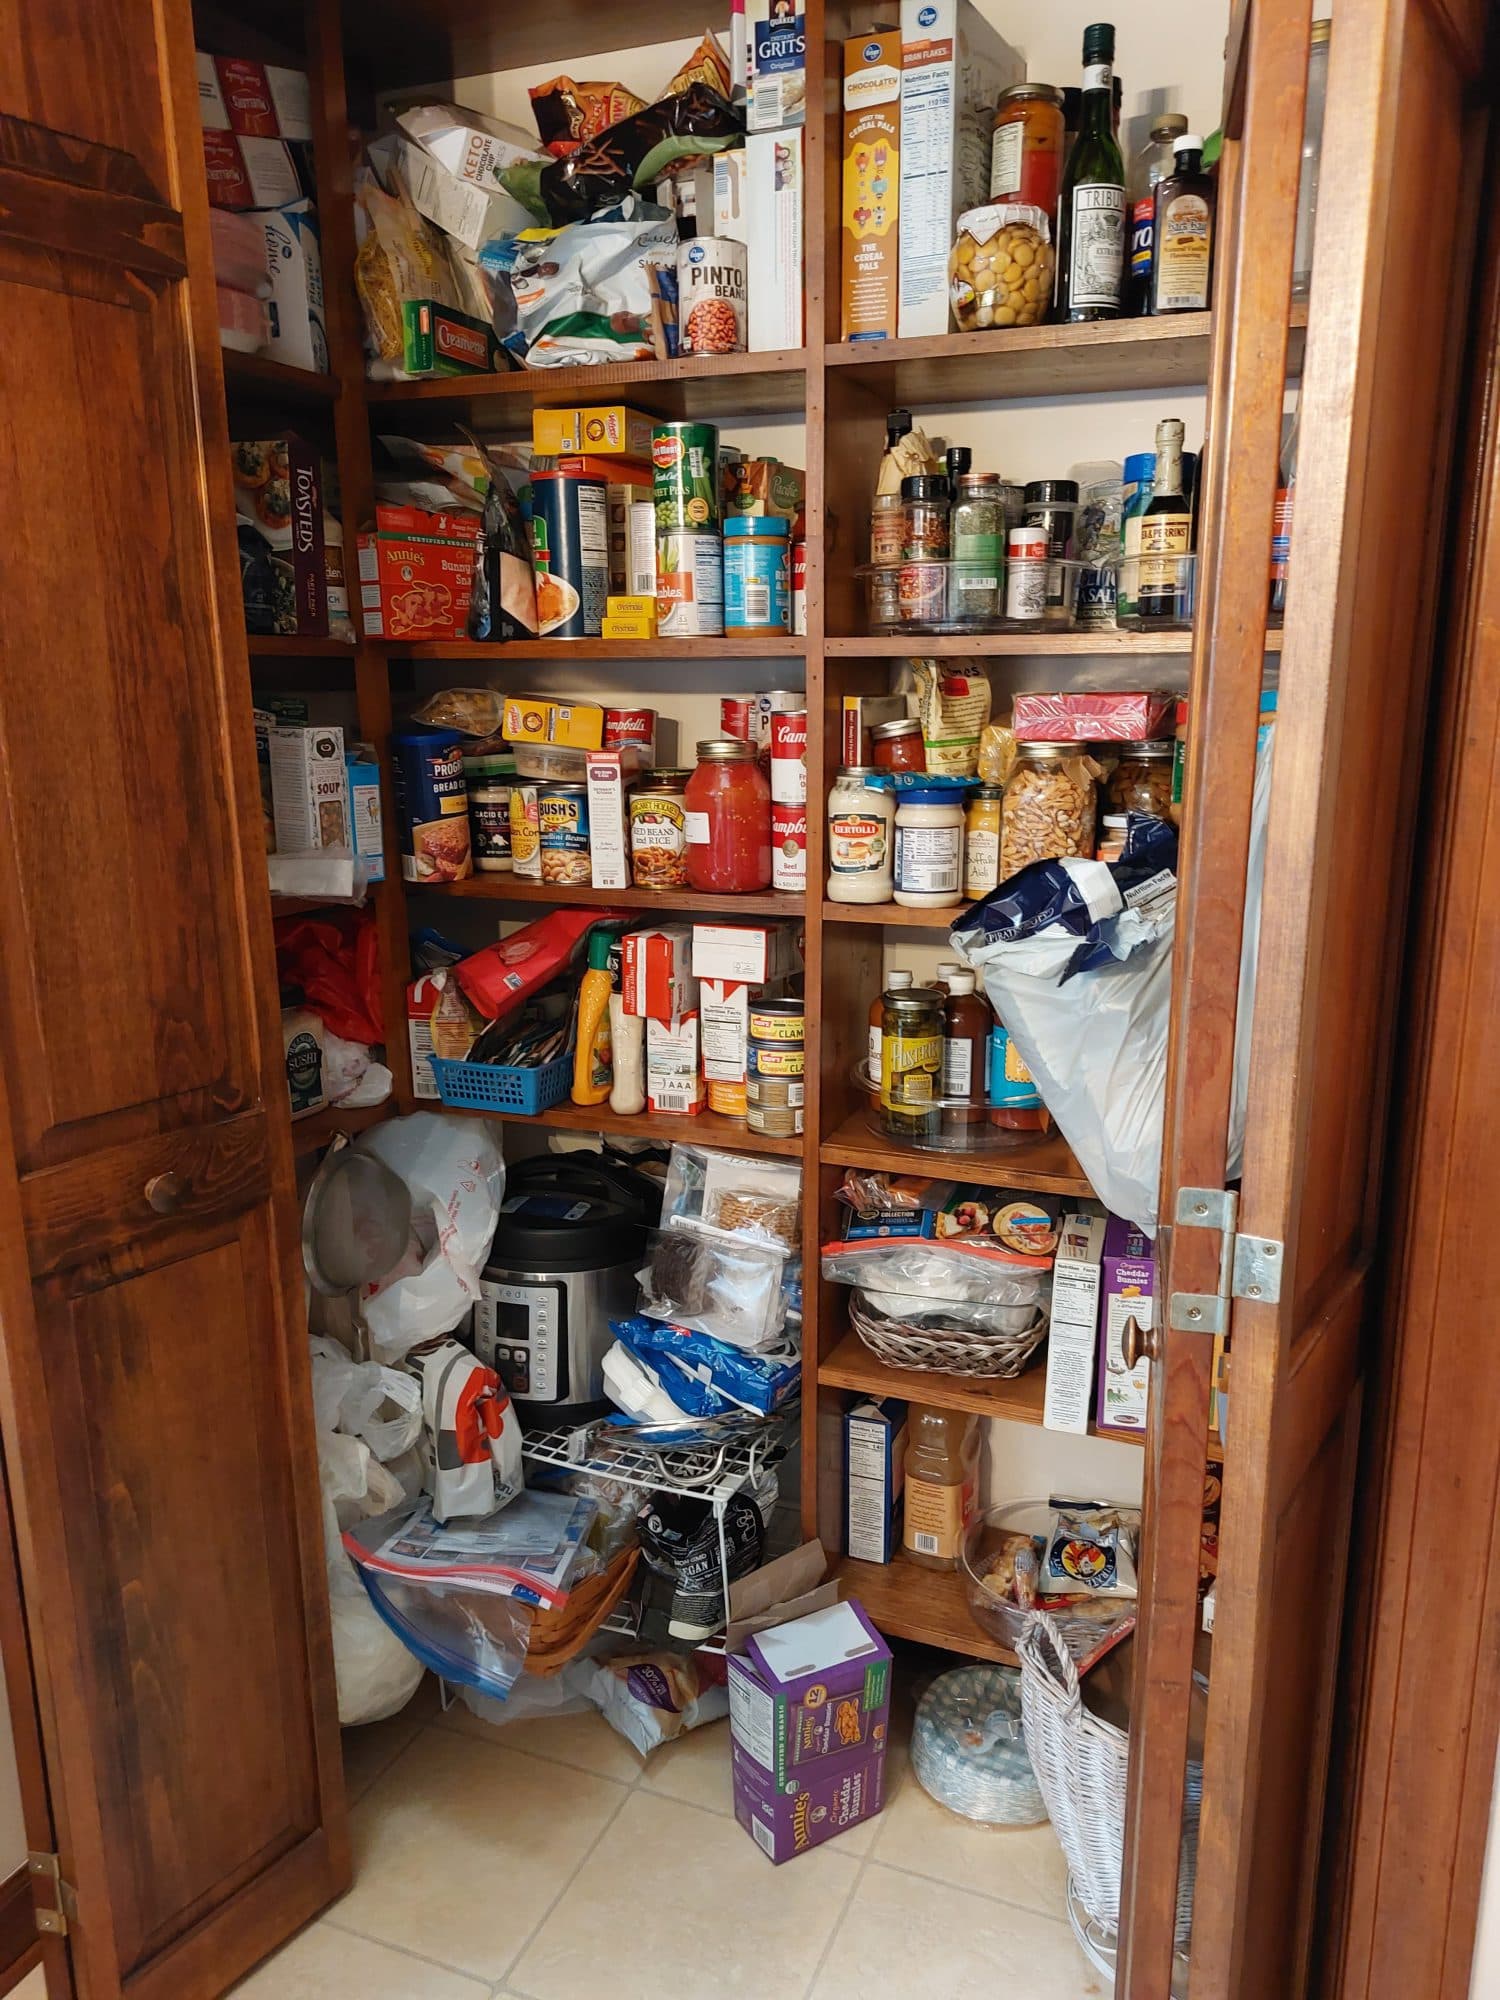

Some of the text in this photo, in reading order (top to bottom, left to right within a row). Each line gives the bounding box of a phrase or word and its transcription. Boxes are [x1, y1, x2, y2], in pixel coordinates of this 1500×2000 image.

[769, 16, 796, 28] QUAKER
[770, 33, 795, 42] INSTANT
[758, 35, 806, 59] GRITS
[922, 47, 947, 59] FLAKES
[769, 60, 795, 71] Original
[904, 71, 950, 83] Nutrition Facts
[462, 135, 485, 180] KETO
[475, 138, 493, 182] CHOCOLATE
[485, 152, 496, 172] CHIP
[862, 243, 877, 252] THE
[853, 252, 885, 262] CEREAL
[858, 261, 880, 271] PALS
[691, 266, 743, 287] PINTO
[296, 465, 315, 553] TOASTEDS
[407, 536, 446, 546] CERTIFIED
[385, 547, 425, 566] Annie's
[442, 559, 471, 575] Bunny
[606, 717, 648, 733] ampbell's
[317, 782, 341, 795] SOUP
[432, 780, 458, 794] BREAD
[539, 802, 578, 819] BUSH'S
[633, 826, 675, 837] RED BEANS
[834, 824, 876, 834] BERTOLLI
[636, 835, 671, 846] and RICE
[783, 862, 798, 870] Beef
[1125, 872, 1171, 900] Nutrition Facts
[704, 1007, 743, 1017] Nutrition Facts
[288, 1051, 318, 1072] SUSHI
[1057, 1263, 1097, 1274] Nutrition Facts
[1115, 1268, 1150, 1279] Cheddar
[1116, 1275, 1149, 1285] Bunnies
[808, 1688, 820, 1705] 12
[803, 1716, 815, 1750] Annie's
[838, 1777, 851, 1826] Cheddar
[848, 1771, 862, 1819] Bunnies
[829, 1789, 841, 1823] Organic
[794, 1792, 810, 1851] Annie's
